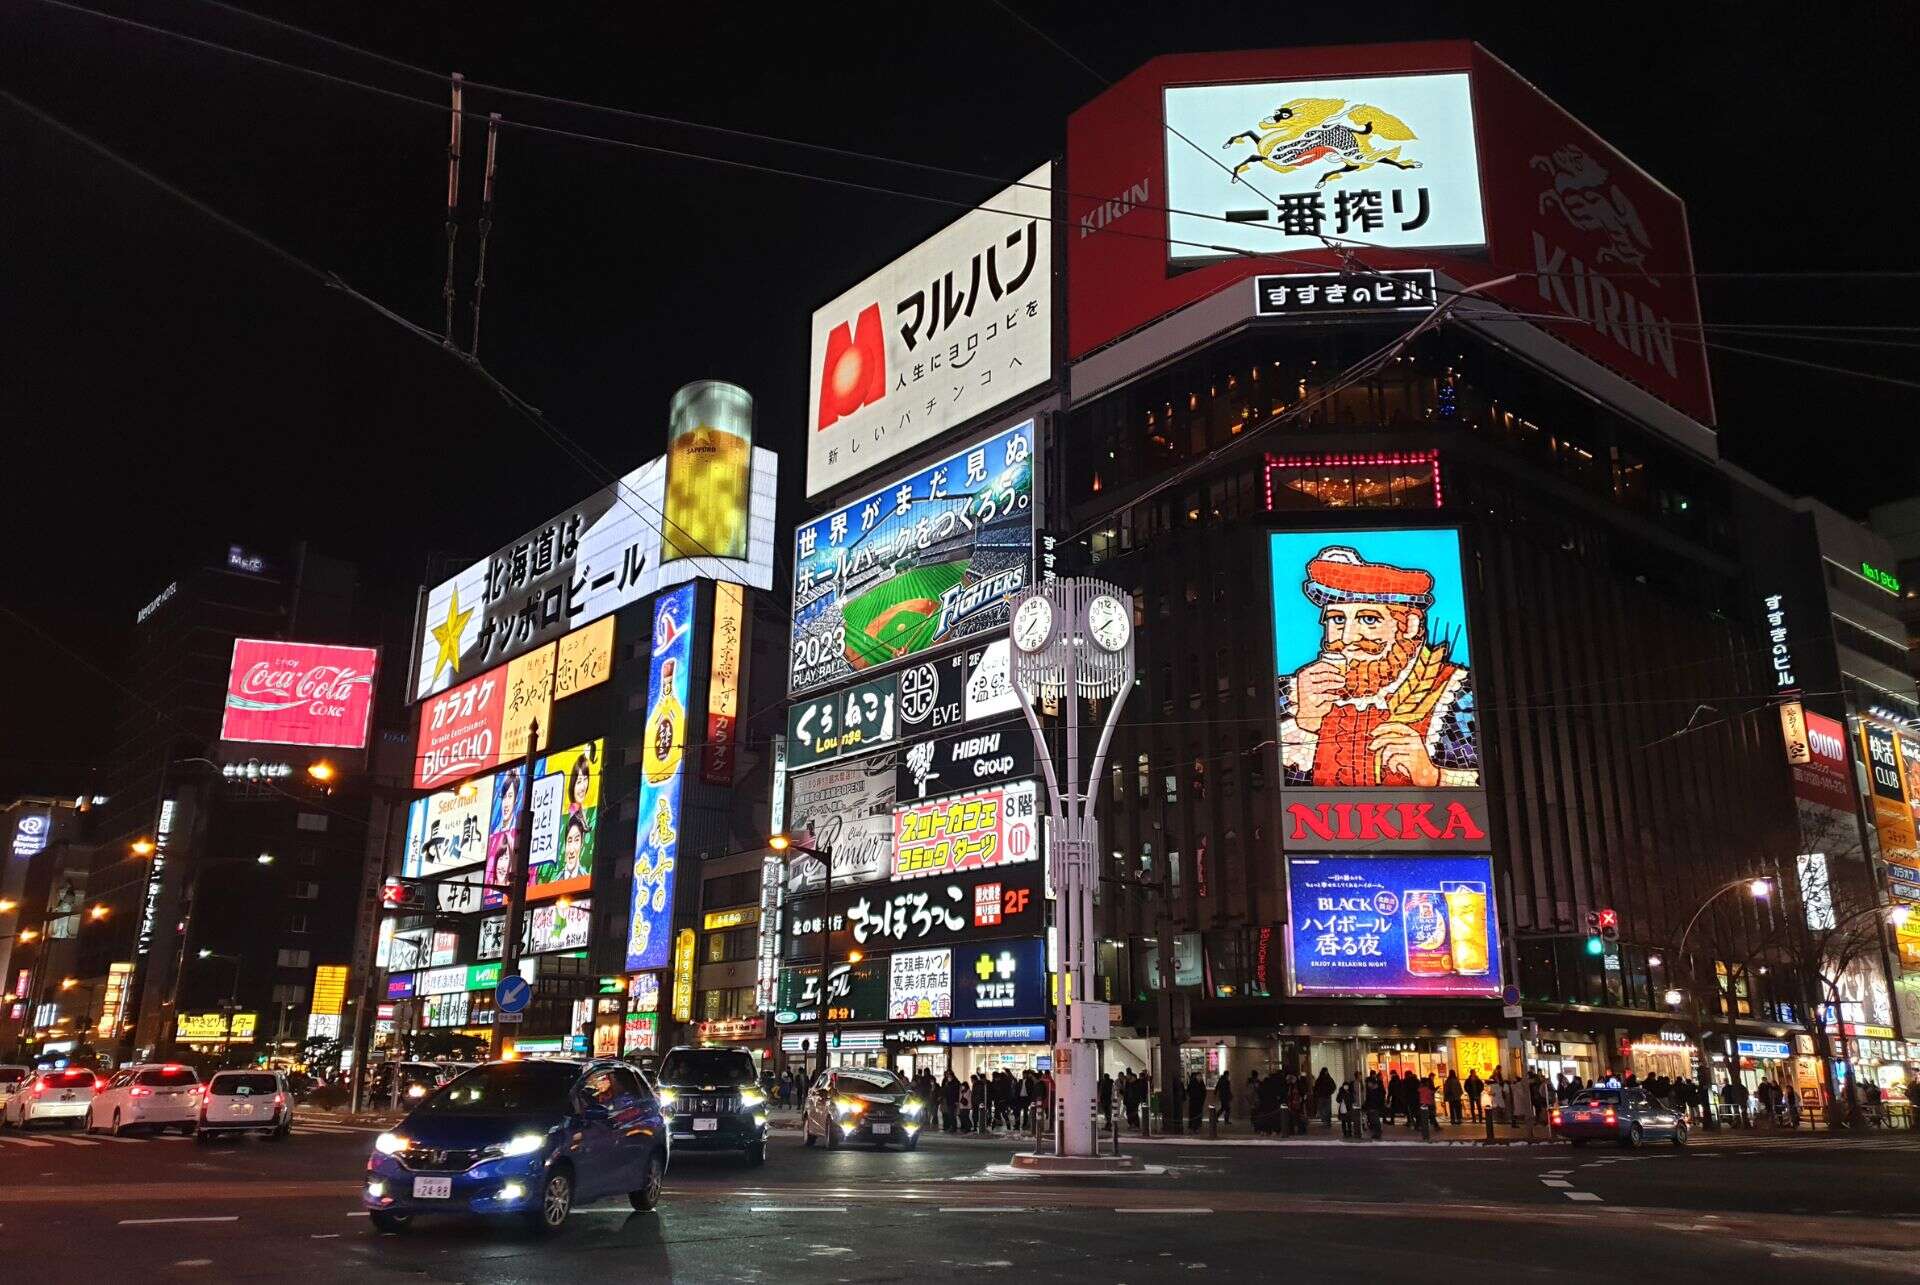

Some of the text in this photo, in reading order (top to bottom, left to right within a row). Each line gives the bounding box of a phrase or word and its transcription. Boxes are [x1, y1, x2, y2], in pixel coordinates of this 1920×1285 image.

[1080, 178, 1150, 239] KIRIN
[1226, 187, 1431, 236] 一番搾り
[897, 219, 1037, 351] マルハン
[1267, 280, 1424, 306] すすきのビル
[1533, 230, 1677, 378] KIRIN
[896, 300, 1038, 391] 人生にヨロコビを
[828, 357, 1022, 465] 新しいパチンコへ
[798, 433, 1029, 560] 世界がまだ見ぬ
[797, 478, 1029, 595] ボールパークをつくろう。
[483, 513, 584, 606] 北海道は
[478, 543, 645, 663] サッポロビール
[933, 565, 1026, 641] FIGHTERS
[793, 626, 846, 672] 2023
[968, 652, 981, 667] 2F
[1764, 594, 1795, 686] すすきのビル
[240, 660, 354, 701] Coca-Cola
[793, 667, 817, 686] PLAY
[308, 701, 346, 718] Coke
[430, 679, 496, 730] カラオケ
[932, 703, 961, 728] EVE
[422, 745, 450, 783] BIG
[450, 729, 493, 761] ECHO
[713, 717, 728, 770] カラオケ
[816, 728, 862, 754] Lounge
[952, 733, 1000, 762] HIBIKI
[1869, 735, 1895, 766] 快活
[973, 754, 1013, 777] Group
[1875, 766, 1899, 789] CLUB
[899, 801, 997, 843] ネットカフェ
[1004, 794, 1033, 818] 8階
[1287, 802, 1486, 841] NIKKA
[897, 835, 996, 872] コミック ダーツ
[848, 886, 965, 944] さっぽろっこ
[1004, 888, 1030, 914] 2F
[1318, 897, 1373, 911] BLACK
[1301, 915, 1392, 933] ハイボール
[1314, 933, 1382, 956] 香る夜
[893, 955, 943, 973] 元祖串かつ
